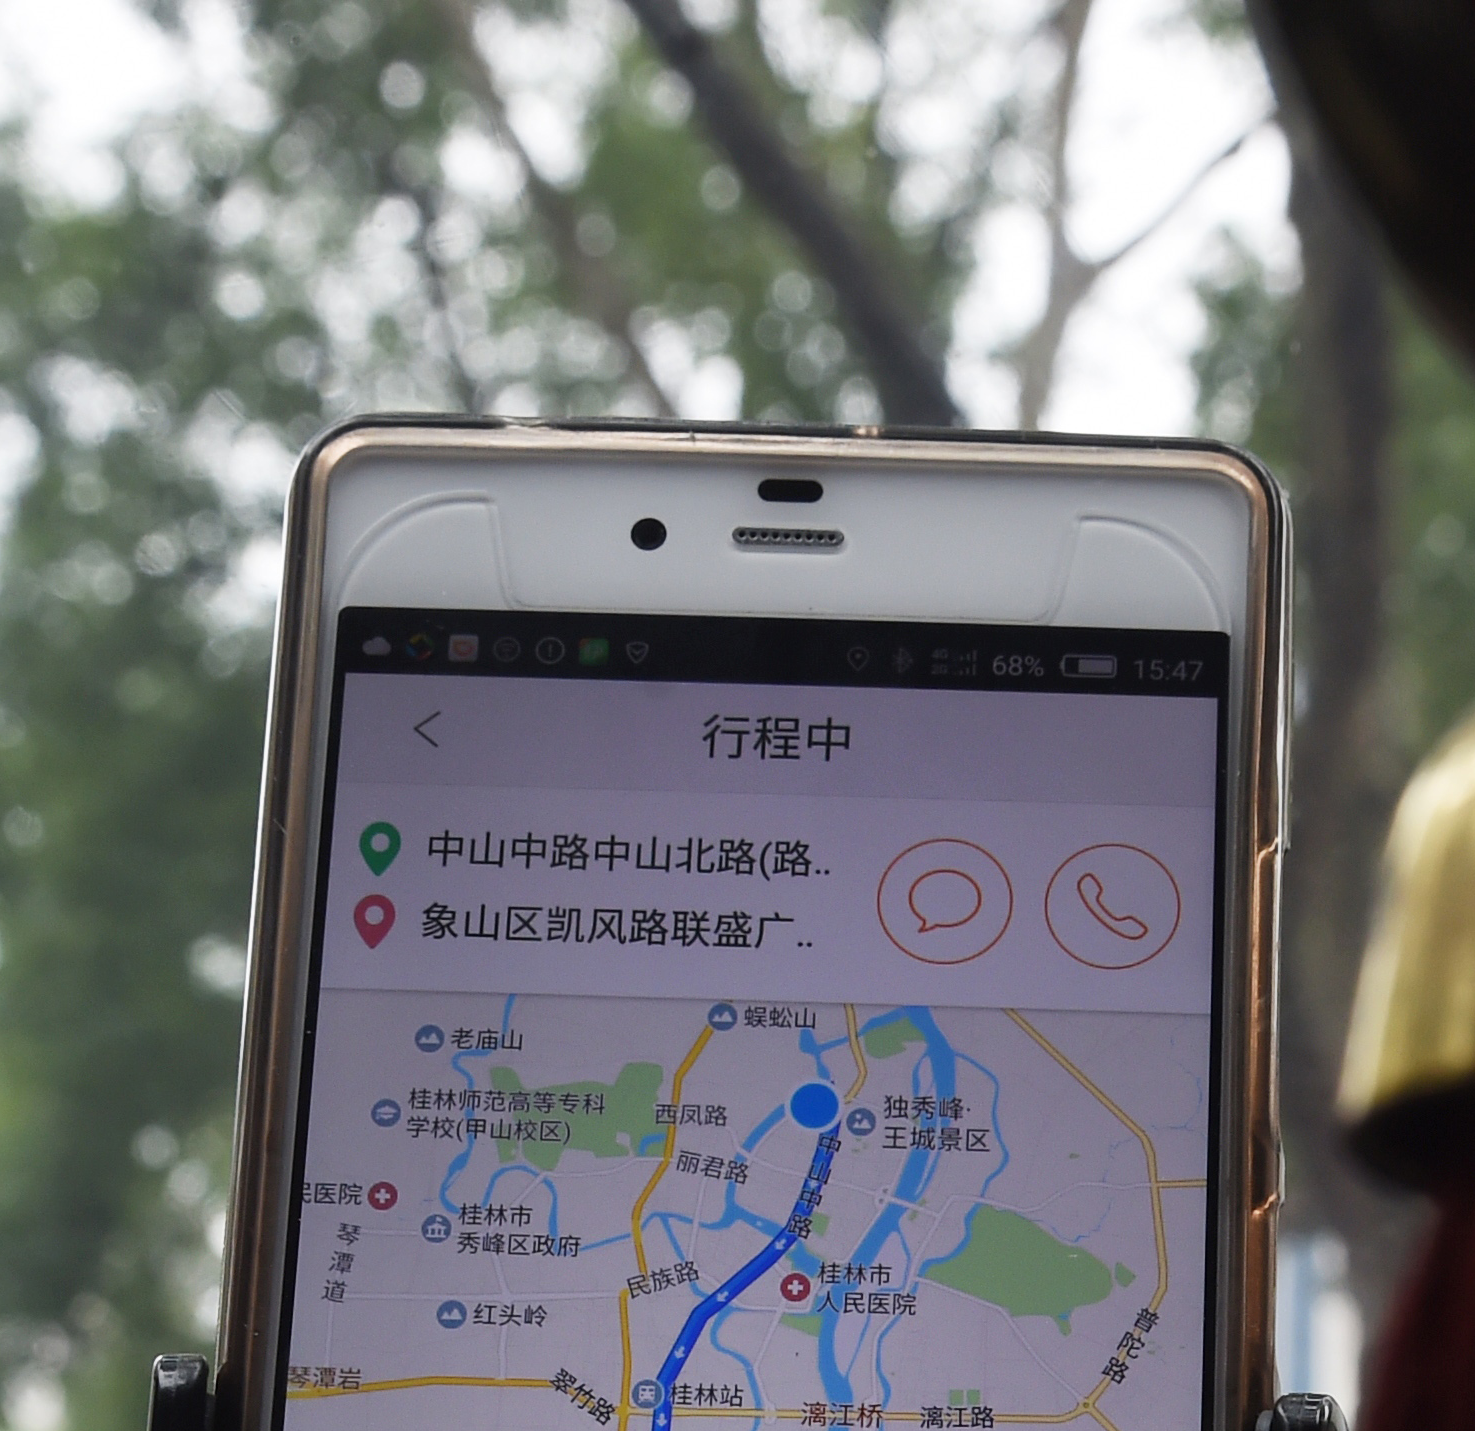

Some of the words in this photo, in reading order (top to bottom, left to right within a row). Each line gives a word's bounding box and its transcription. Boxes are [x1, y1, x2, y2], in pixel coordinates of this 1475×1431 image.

[992, 655, 1044, 677] 68%
[1133, 659, 1204, 681] 15:47
[703, 714, 852, 763] 行程中
[427, 828, 831, 880] 中山中路中山北路(路..
[422, 902, 814, 951] 象山区凯风路联盛广..
[744, 1006, 816, 1030] 蜈蚣山
[451, 1028, 523, 1052] 老庙山
[408, 1089, 605, 1115] 桂林师范高等专科
[655, 1103, 727, 1127] 西凤路
[406, 1117, 571, 1144] 学校(甲山校区)
[883, 1126, 991, 1152] 王城景区
[676, 1150, 749, 1184] 丽君路
[788, 1134, 842, 1239] 中山中路
[458, 1203, 533, 1227] 桂林市
[457, 1233, 581, 1258] 秀峰区政府
[321, 1222, 361, 1303] 琴潭道
[818, 1262, 892, 1286] 桂林市
[627, 1262, 700, 1299] 民族路
[473, 1304, 547, 1328] 红头岭
[817, 1291, 917, 1316] 人民医院
[1102, 1307, 1160, 1384] 普陀路
[549, 1368, 616, 1426] 翠竹路
[669, 1384, 743, 1407] 桂林站
[801, 1402, 883, 1429] 漓江桥
[919, 1406, 995, 1430] 漓江路
